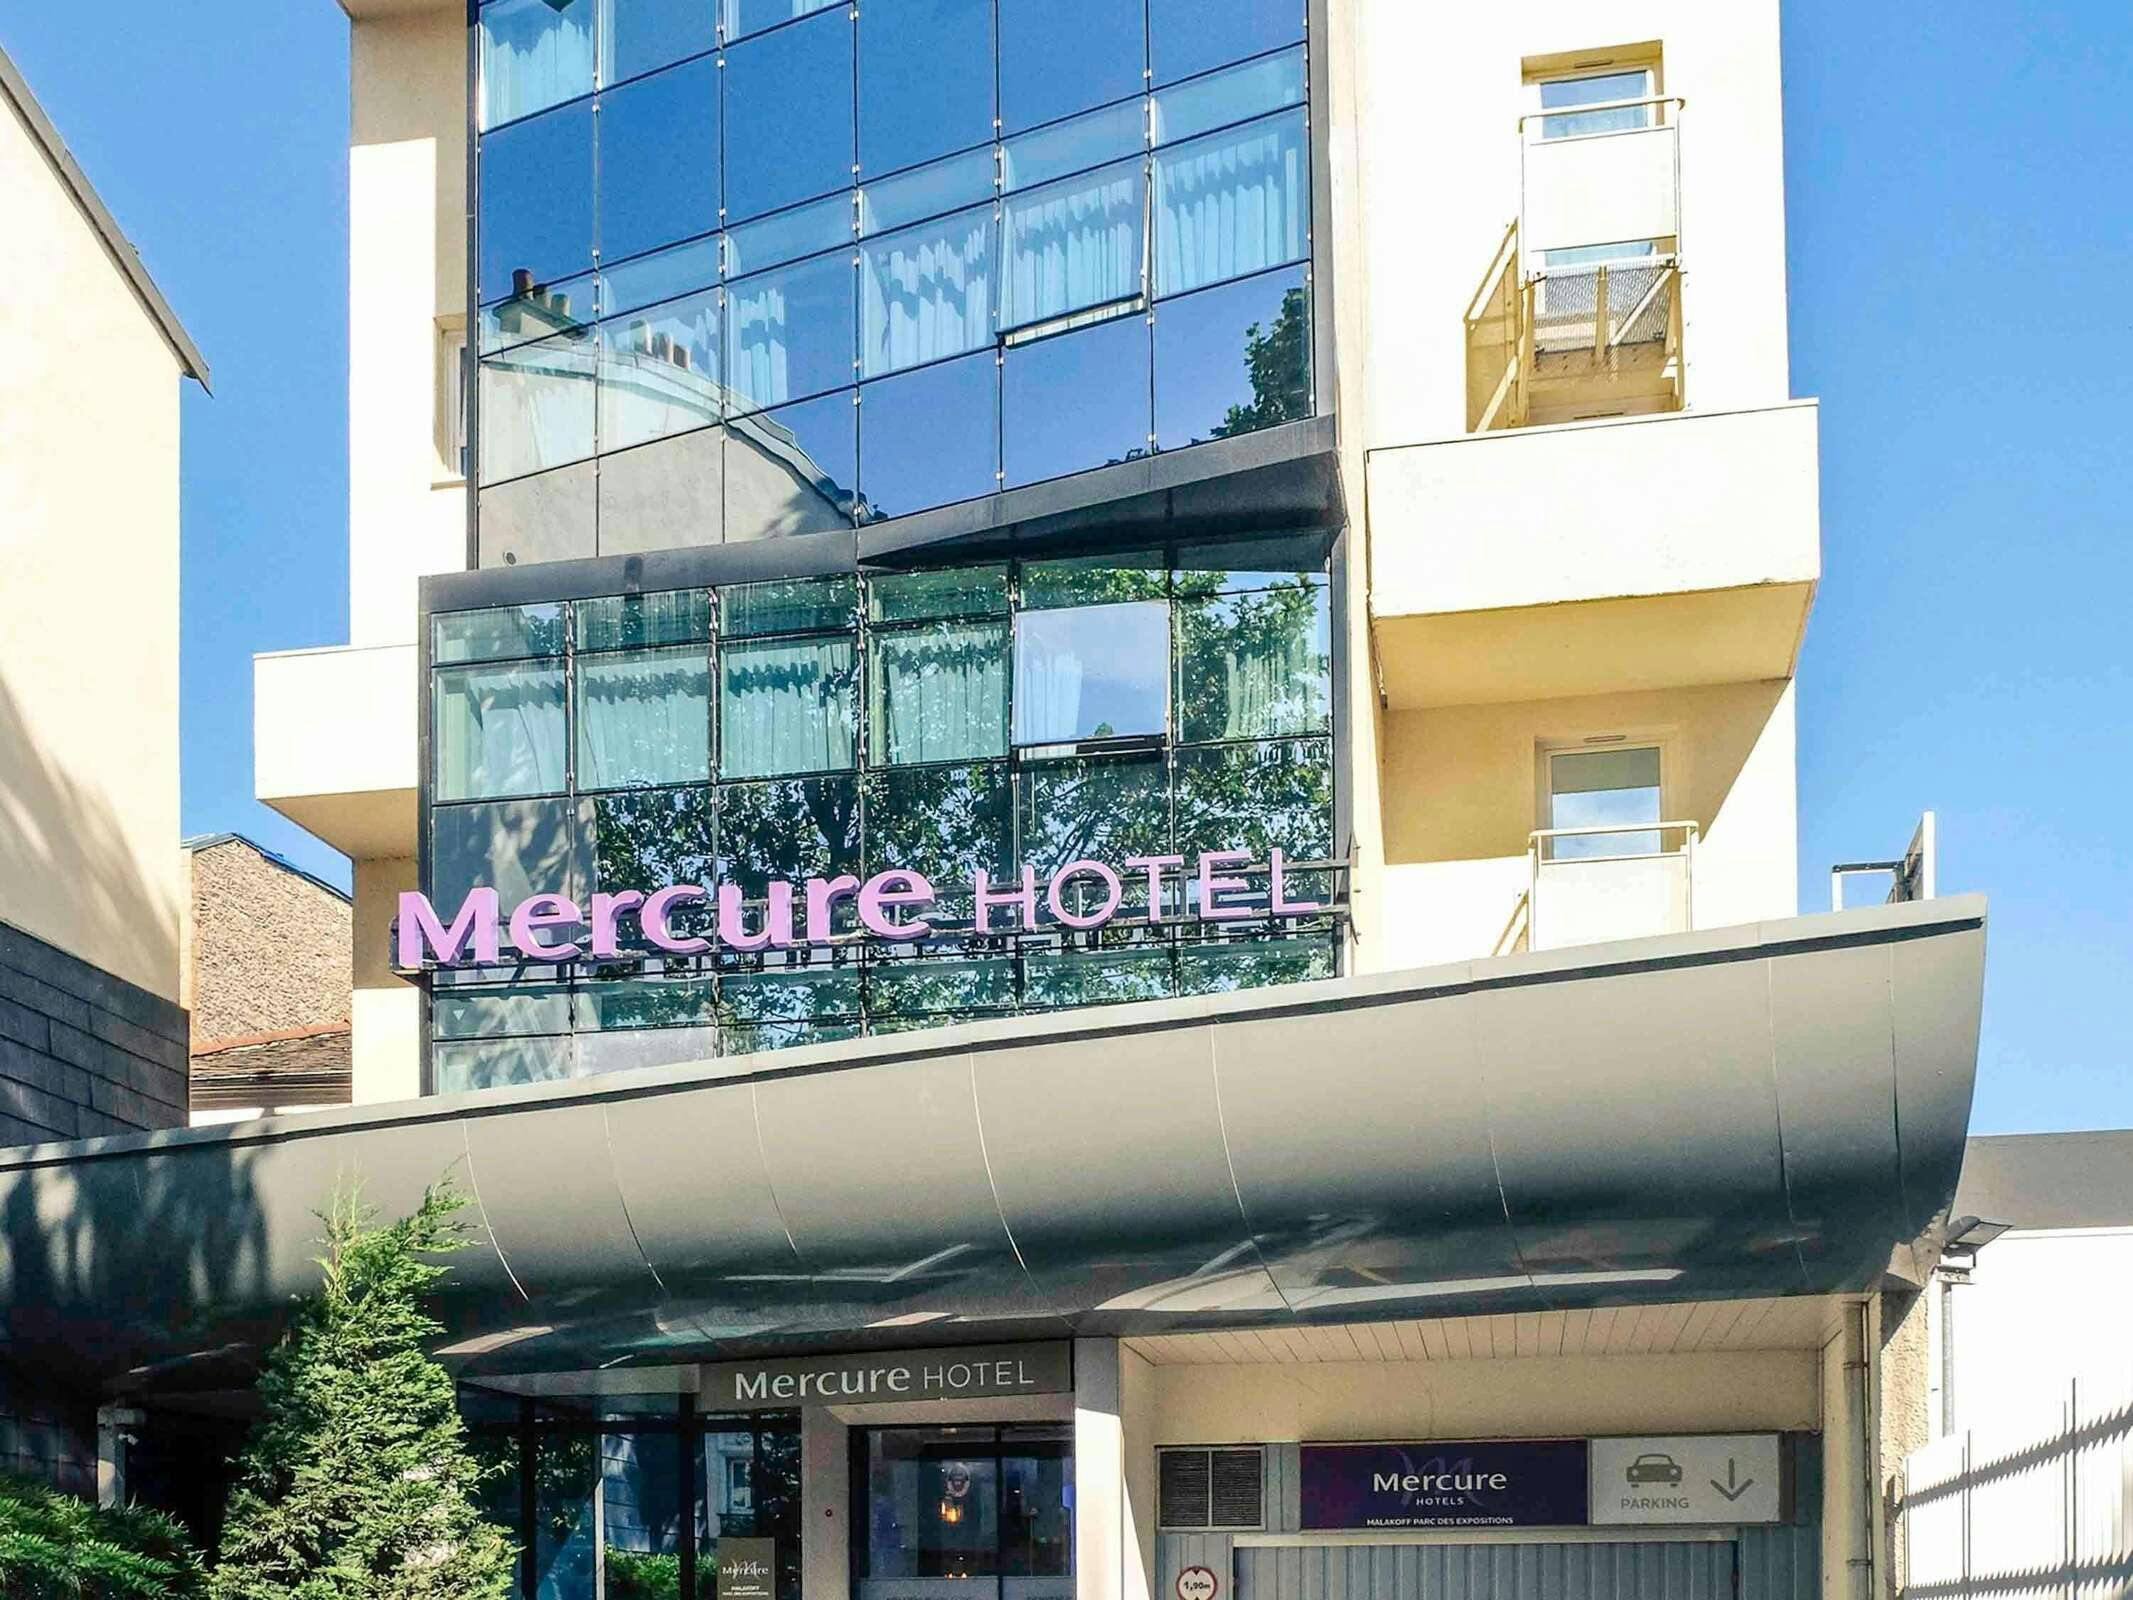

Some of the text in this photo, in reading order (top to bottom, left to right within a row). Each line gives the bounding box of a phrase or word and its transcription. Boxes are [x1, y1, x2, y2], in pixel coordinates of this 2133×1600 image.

[394, 846, 1321, 970] Mercure HOTEL
[735, 1360, 1035, 1400] Mercure HOTEL
[1373, 1472, 1508, 1492] Mercure
[1415, 1496, 1465, 1506] HOTELS
[1620, 1497, 1690, 1510] PARKING
[1366, 1516, 1515, 1527] MALAKOFF PARC DES EXPOSITIONS
